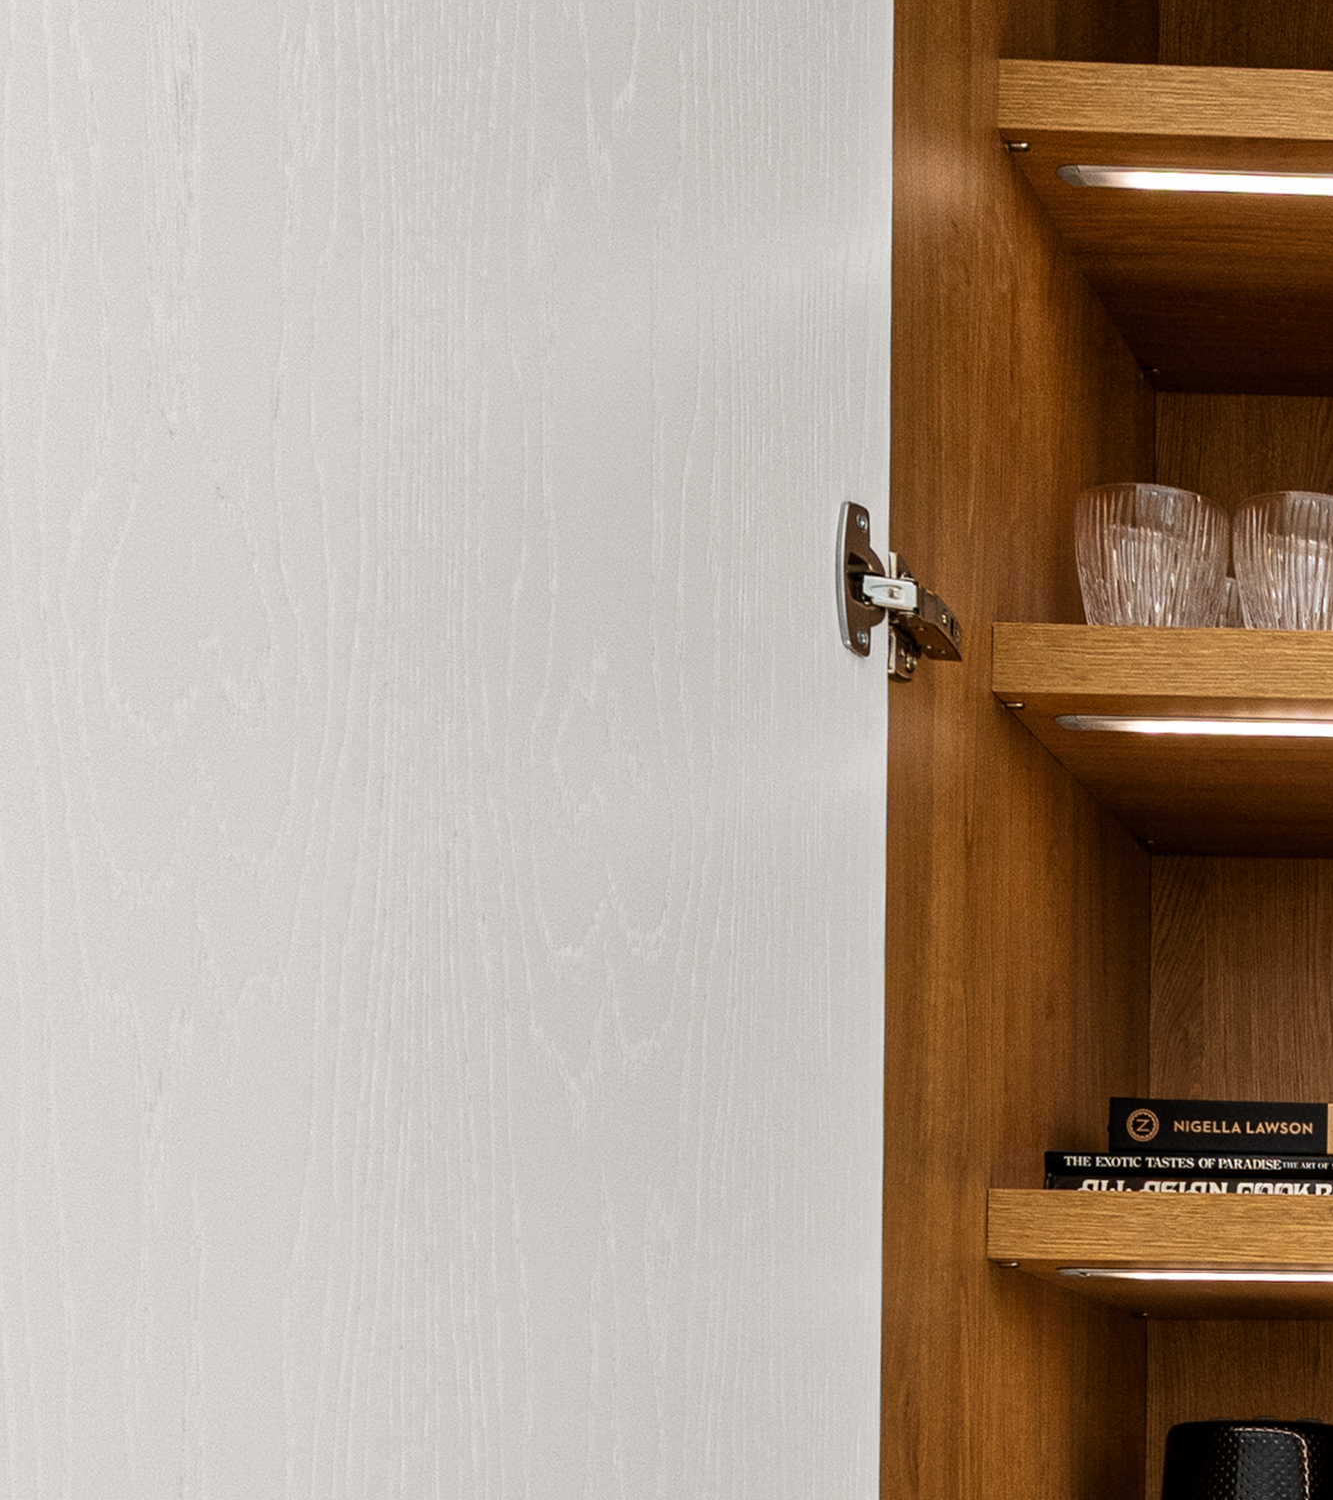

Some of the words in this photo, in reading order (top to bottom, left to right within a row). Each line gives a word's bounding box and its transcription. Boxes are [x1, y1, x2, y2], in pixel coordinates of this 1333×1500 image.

[1173, 1119, 1242, 1134] NIGELLA
[1246, 1121, 1314, 1135] LAWSON
[1064, 1155, 1092, 1167] THE
[1095, 1156, 1142, 1168] EXOTIC
[1145, 1156, 1195, 1169] TASTES
[1198, 1157, 1216, 1169] OF
[1218, 1157, 1282, 1170] PARADISE
[1282, 1161, 1299, 1169] THE
[1300, 1161, 1316, 1170] ART
[1317, 1162, 1329, 1170] OF
